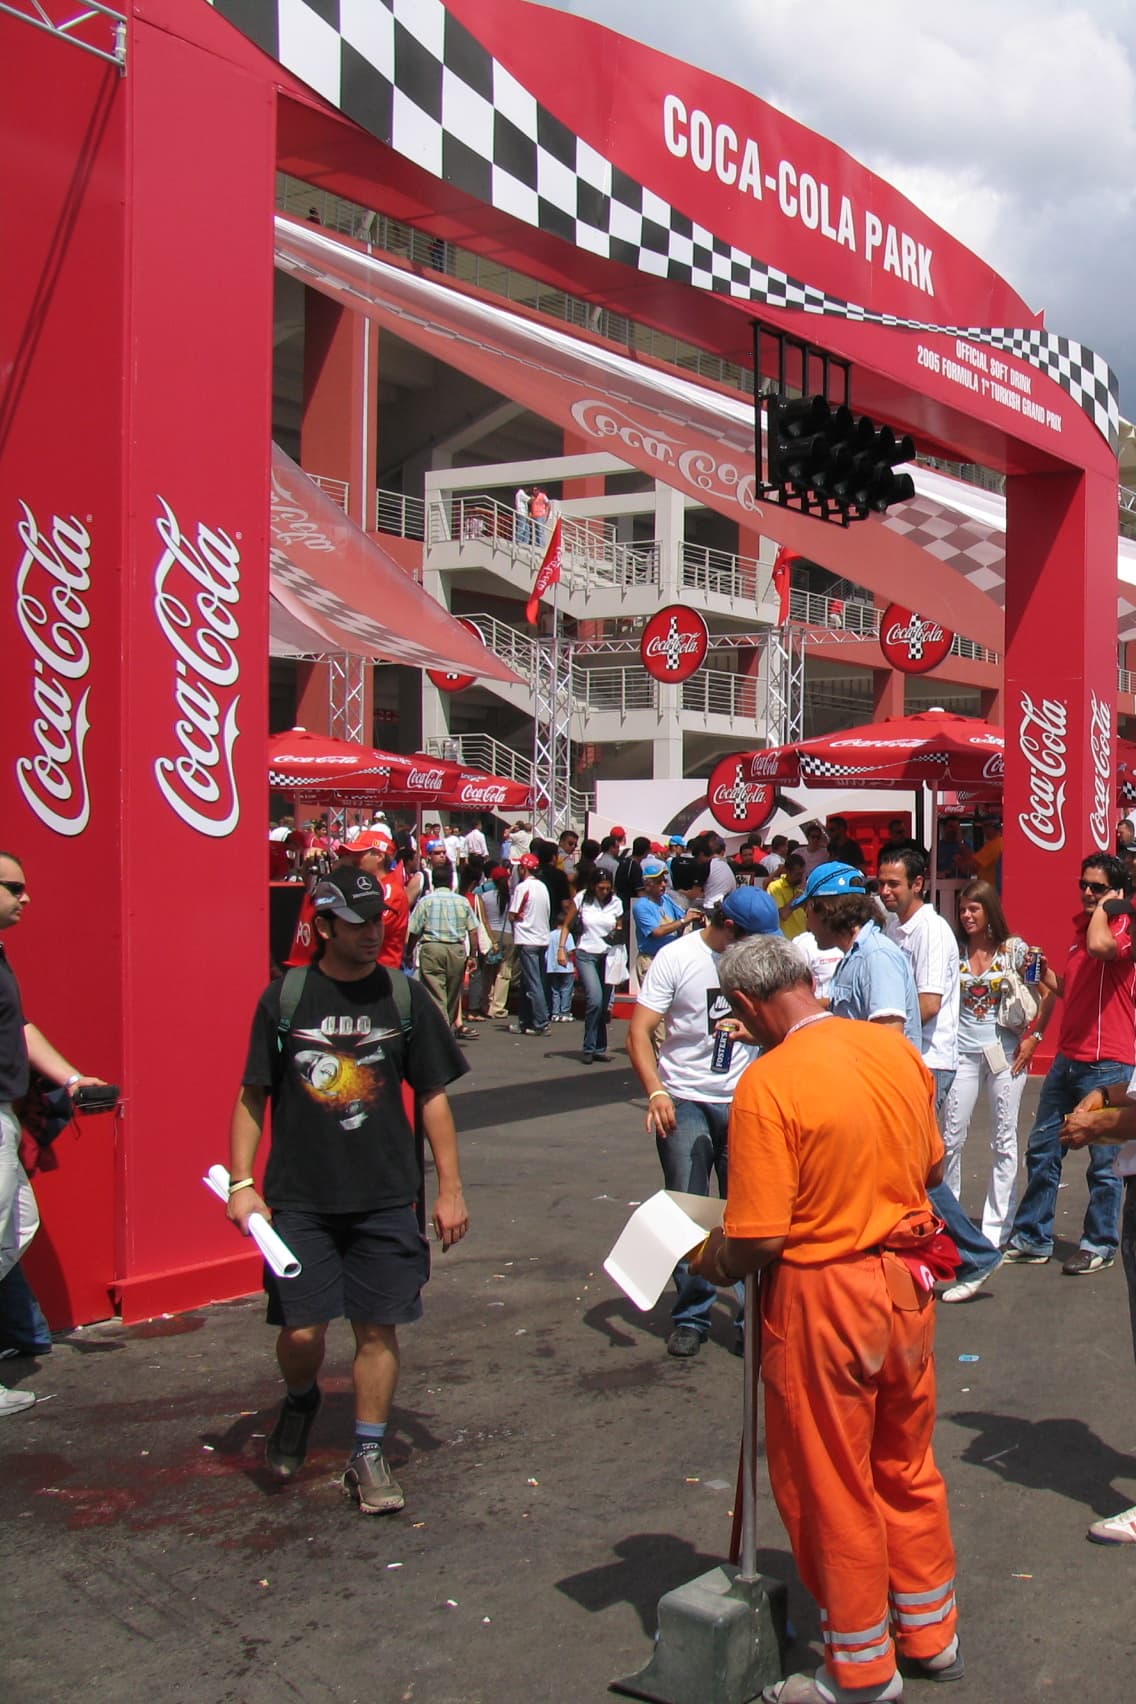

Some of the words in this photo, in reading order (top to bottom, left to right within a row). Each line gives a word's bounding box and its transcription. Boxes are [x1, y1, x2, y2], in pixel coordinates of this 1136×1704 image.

[664, 94, 856, 252] COCA-COLA
[865, 210, 934, 296] PARK
[917, 345, 940, 373] 2005
[942, 357, 979, 392] FORMULA
[990, 380, 1021, 412] TURKISH
[1022, 397, 1046, 424] GRAND
[1045, 410, 1062, 432] PRIX
[956, 339, 988, 373] OFFICIAL
[990, 357, 1008, 382] SOFT
[1010, 367, 1032, 395] DRINK
[17, 498, 91, 837] Coca-Cola
[155, 494, 241, 838] Coca-Cola
[1018, 690, 1067, 851] Coca-Cola
[1089, 688, 1111, 851] Coca-Cola
